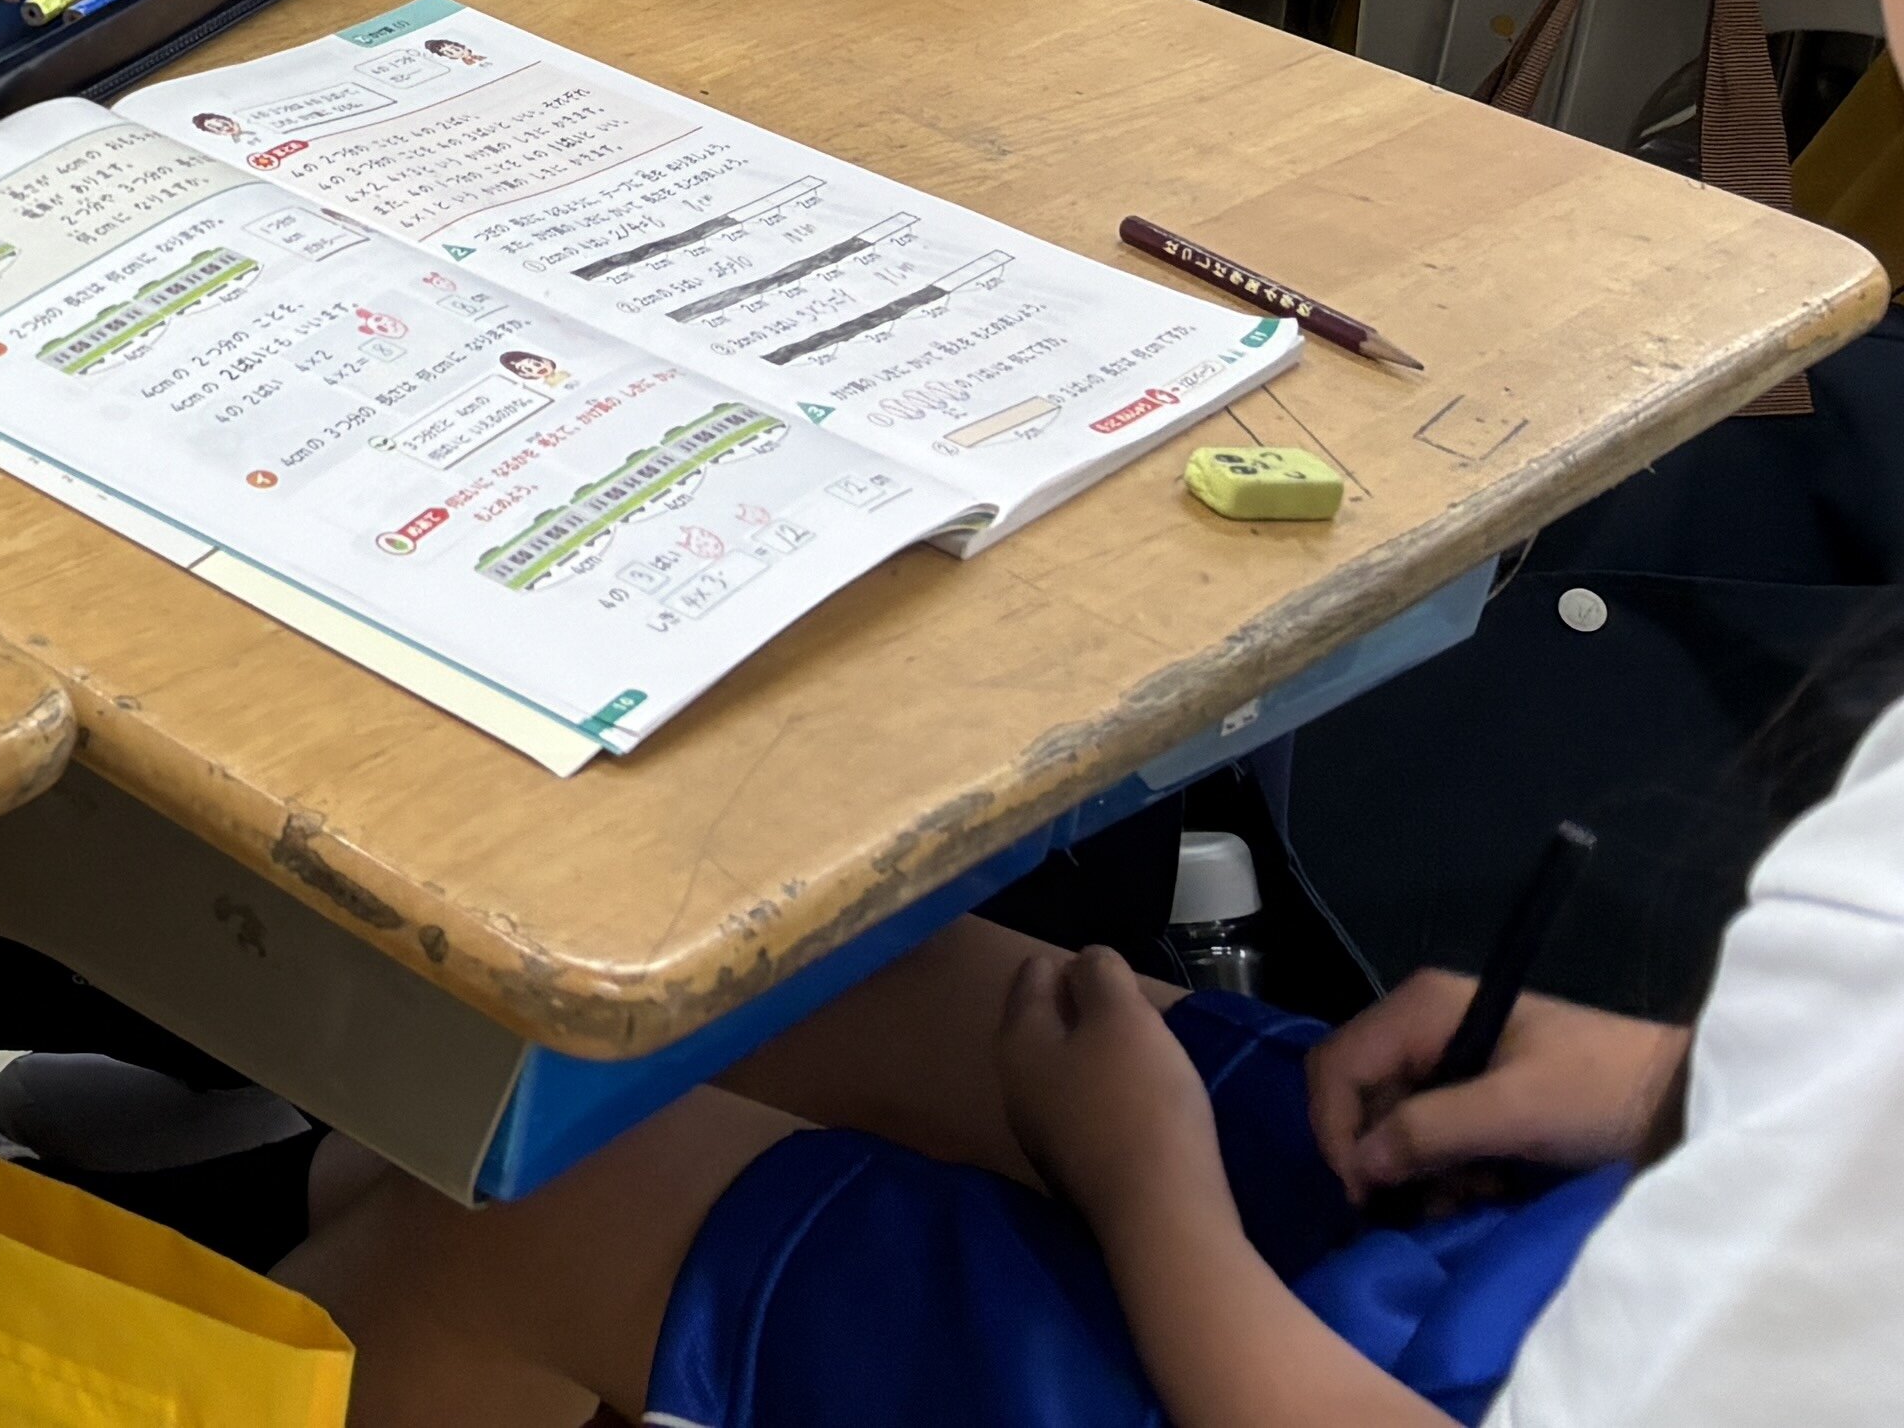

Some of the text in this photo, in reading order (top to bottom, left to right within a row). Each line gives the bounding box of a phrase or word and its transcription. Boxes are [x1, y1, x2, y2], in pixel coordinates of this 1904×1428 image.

[8, 307, 67, 339] 2つ分の
[135, 298, 306, 399] 4cmの 2つ分の ことを、
[164, 298, 359, 413] 4cmの 2ばいとも いいます。
[210, 403, 247, 423] 4の
[238, 377, 290, 405] 2ばい
[274, 437, 330, 466] 4cmの
[319, 405, 379, 438] 3つ分の
[567, 554, 606, 575] 4cm
[591, 586, 634, 609] 4の
[641, 610, 686, 633] しき
